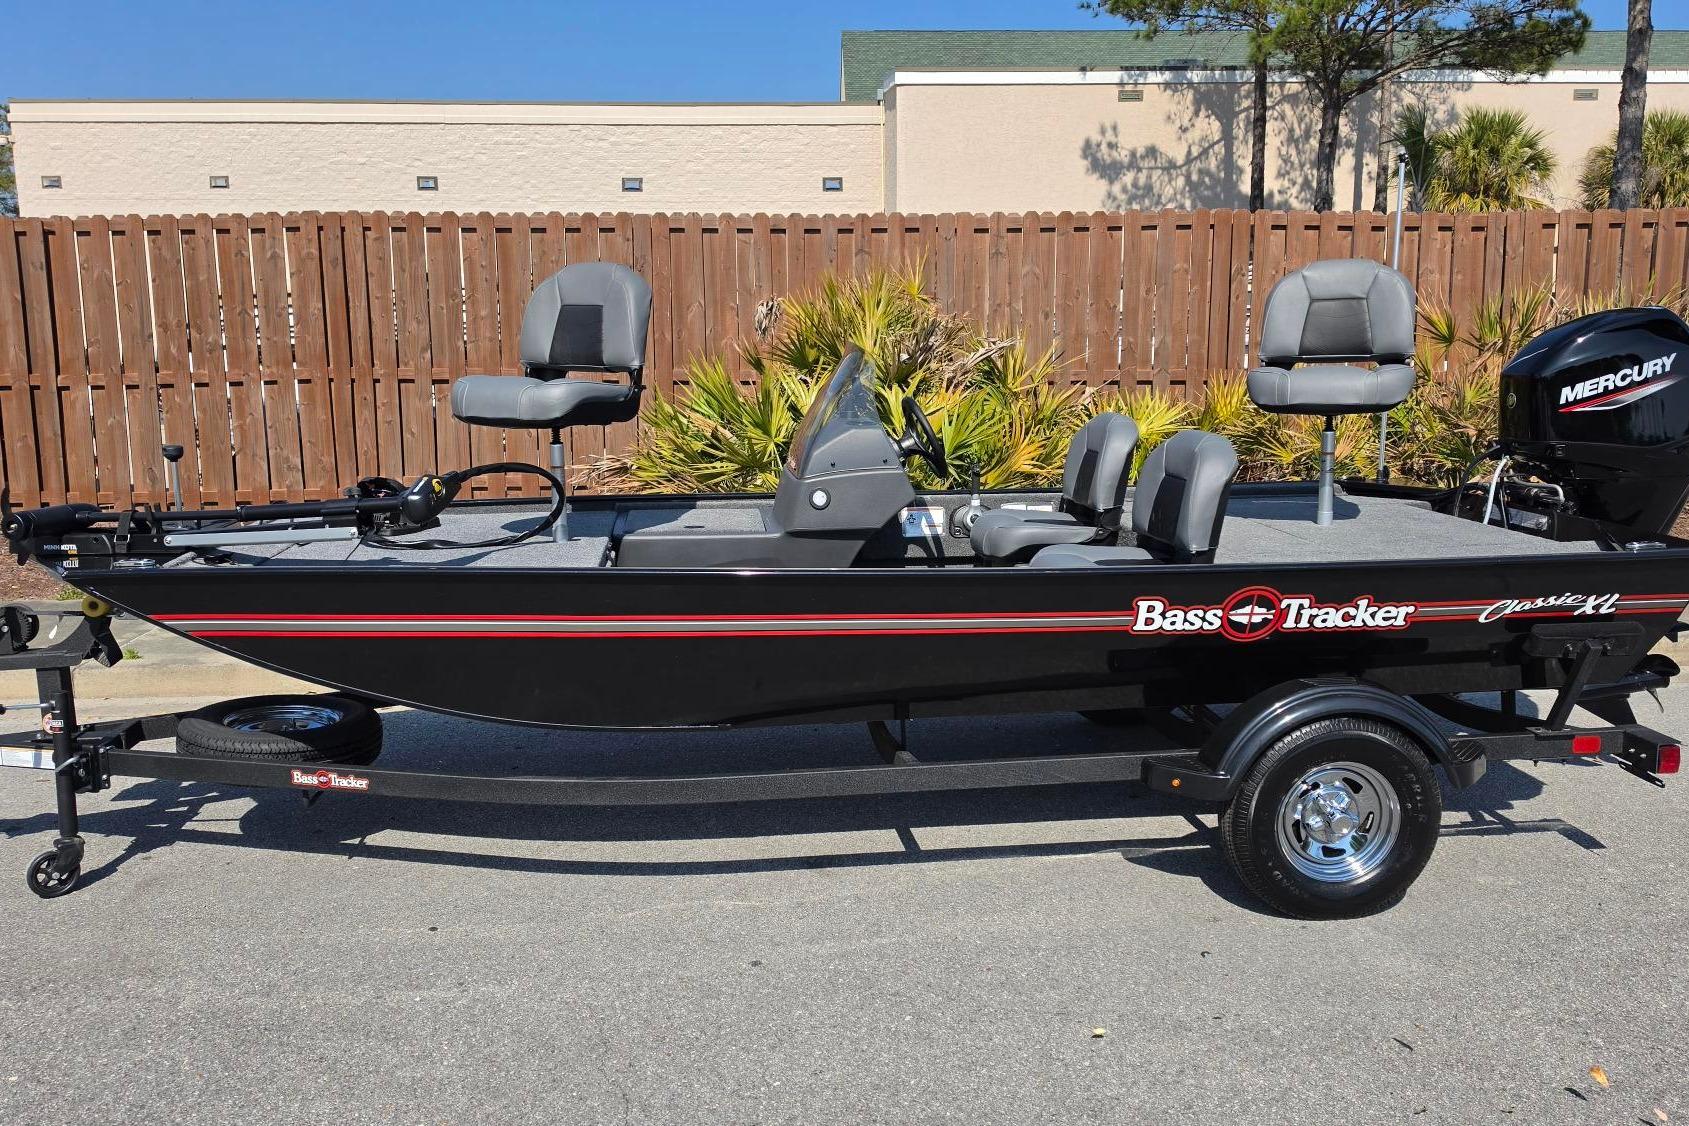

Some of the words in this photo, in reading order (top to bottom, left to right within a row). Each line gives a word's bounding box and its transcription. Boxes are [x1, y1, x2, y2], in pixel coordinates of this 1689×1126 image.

[1559, 352, 1677, 405] MERCURY
[1132, 600, 1223, 631] Bass
[1280, 598, 1416, 629] Tracker
[1478, 592, 1587, 623] Classic
[1573, 593, 1620, 616] XL
[293, 771, 319, 785] Bass
[329, 773, 368, 788] Tracker
